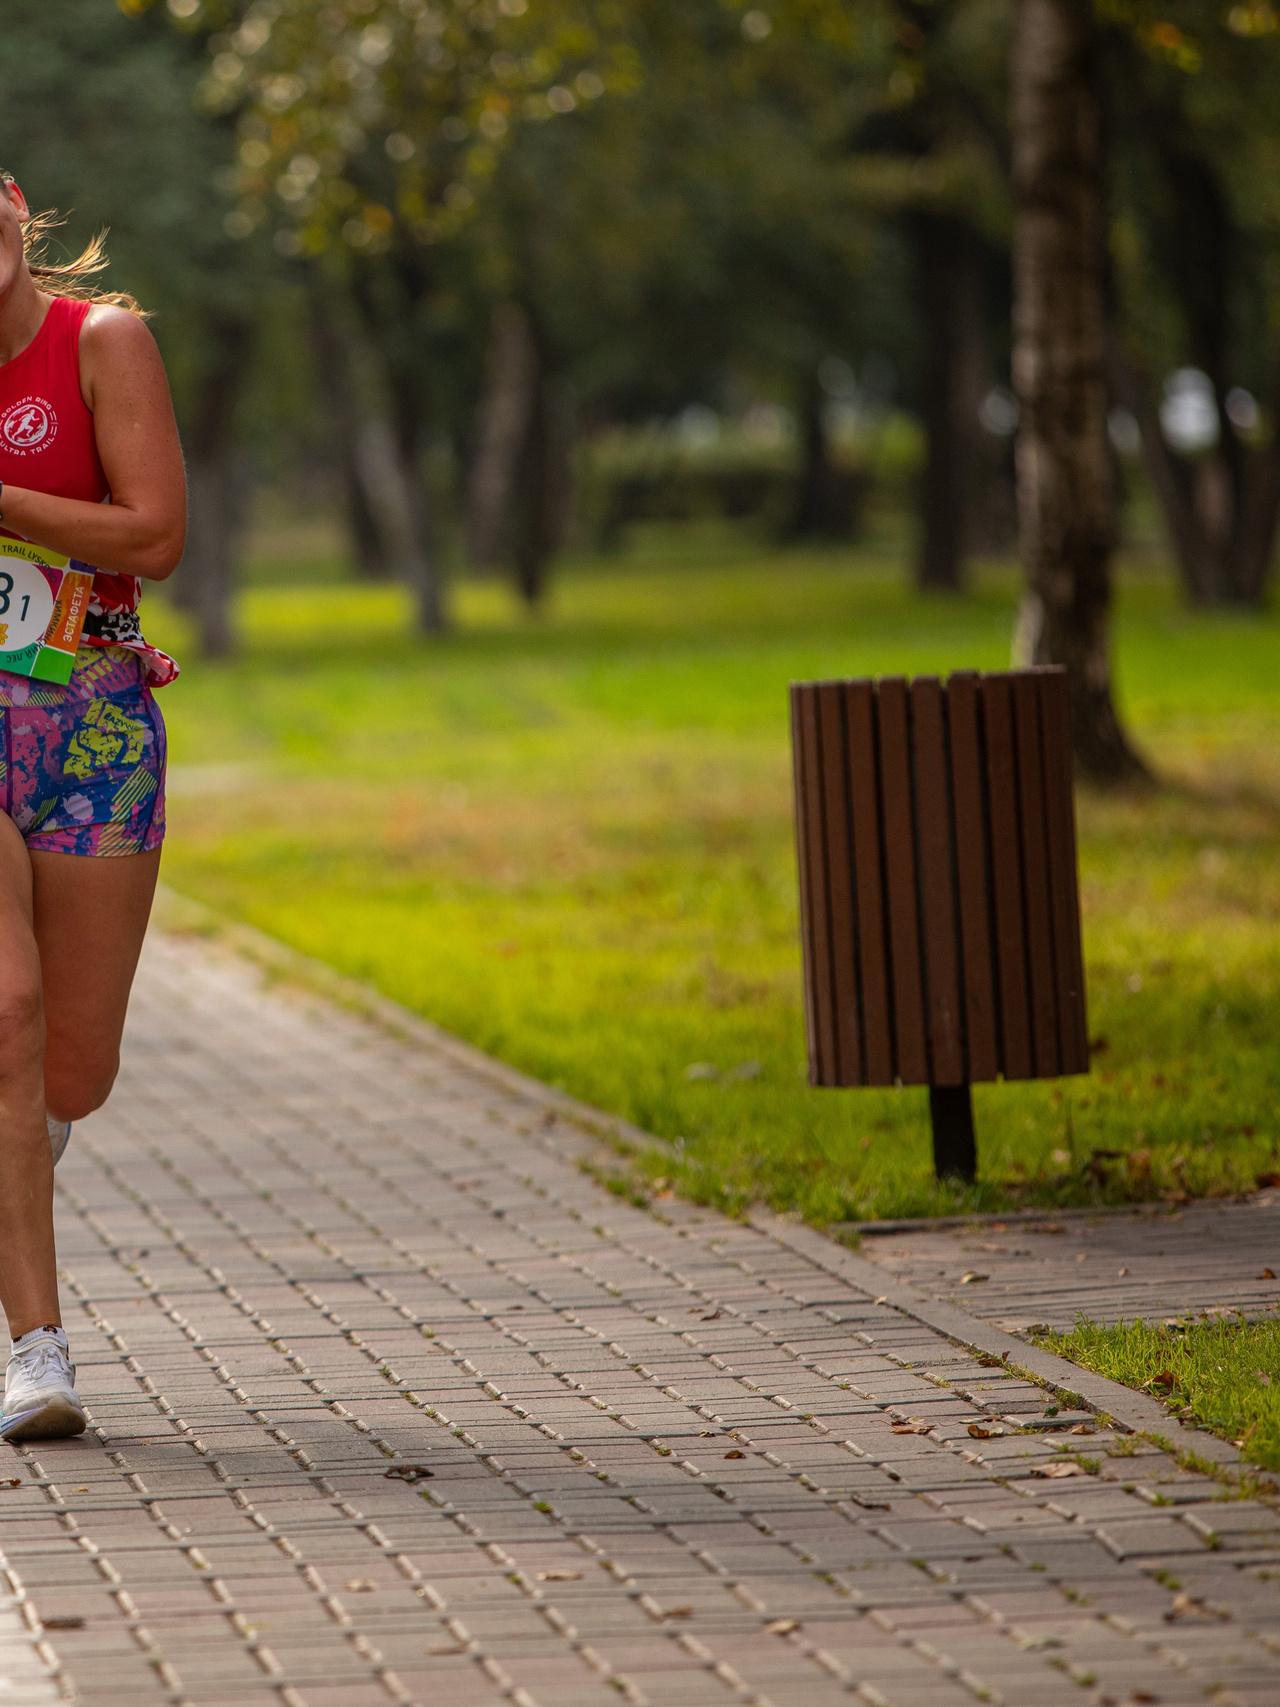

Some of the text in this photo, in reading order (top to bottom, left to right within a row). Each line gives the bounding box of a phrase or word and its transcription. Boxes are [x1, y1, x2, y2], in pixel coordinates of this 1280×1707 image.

[1, 396, 52, 418] GOLDEN RING
[0, 437, 54, 456] ULTRA TRAIL
[2, 545, 26, 556] TRAIL
[27, 551, 58, 583] LYSKOVO
[62, 586, 85, 643] ЭСТАФЕТА
